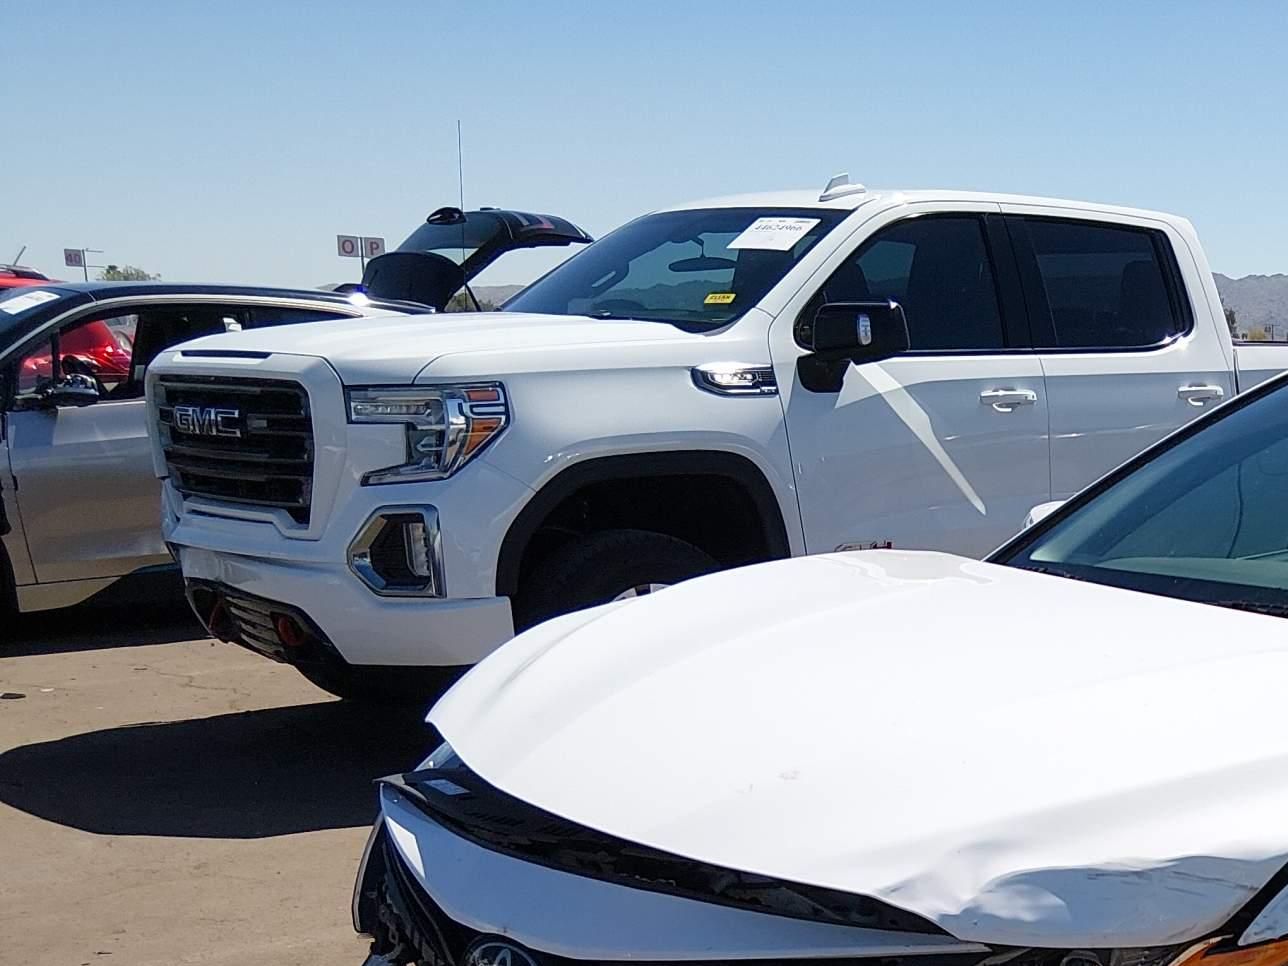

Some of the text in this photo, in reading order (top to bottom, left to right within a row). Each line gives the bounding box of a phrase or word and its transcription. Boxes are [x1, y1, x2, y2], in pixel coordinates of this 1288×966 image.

[342, 239, 354, 254] O
[370, 241, 380, 255] P
[174, 406, 241, 437] GMC
